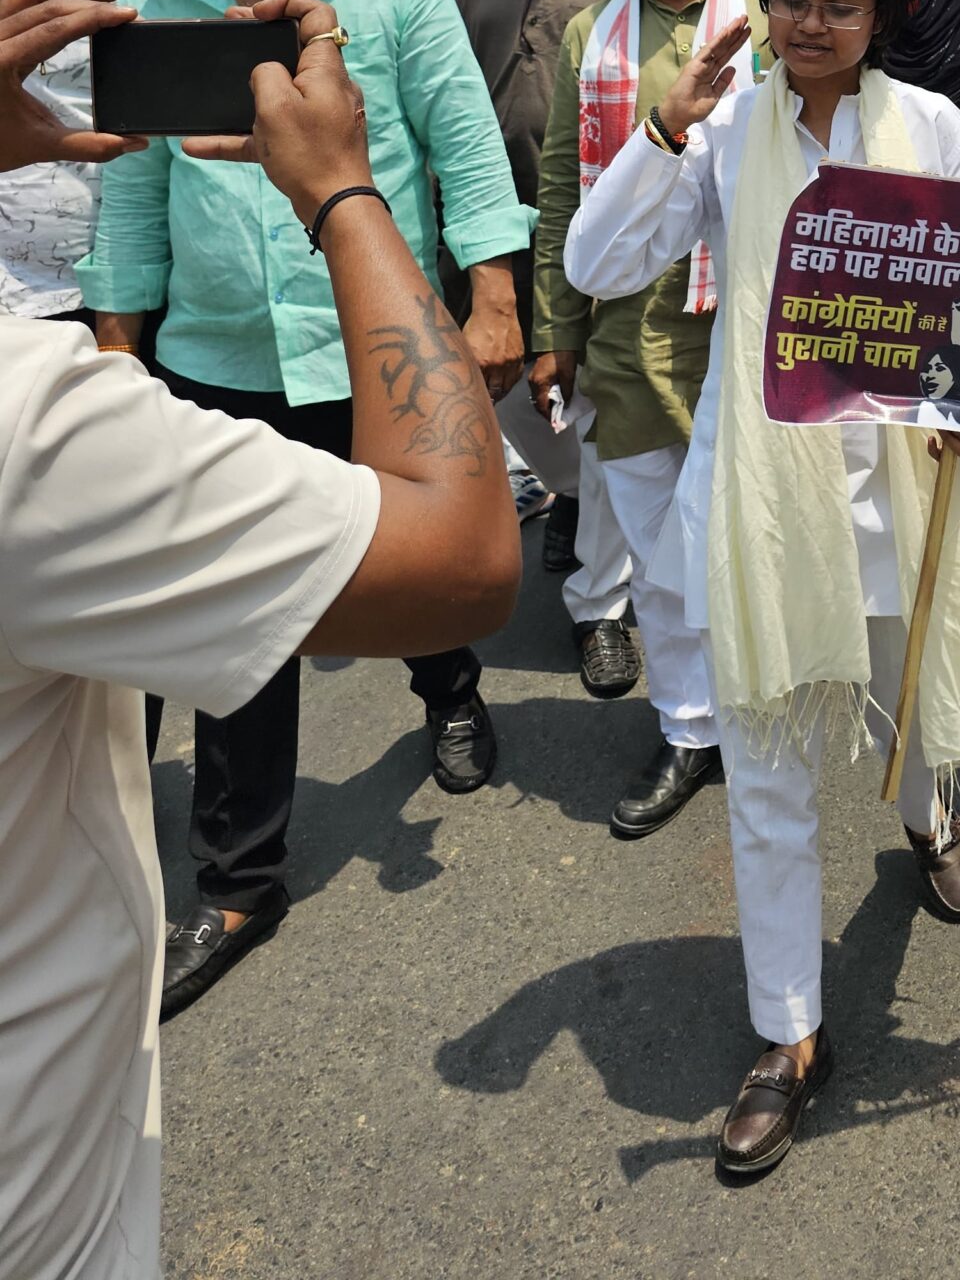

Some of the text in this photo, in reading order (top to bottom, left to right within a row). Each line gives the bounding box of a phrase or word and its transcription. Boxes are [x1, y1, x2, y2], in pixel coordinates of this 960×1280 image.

[795, 208, 930, 254] महिलाओं
[790, 242, 841, 274] हक
[844, 249, 884, 281] पर
[781, 290, 948, 335] कांग्रेसियों की है
[776, 332, 920, 372] पुरानी चाल
